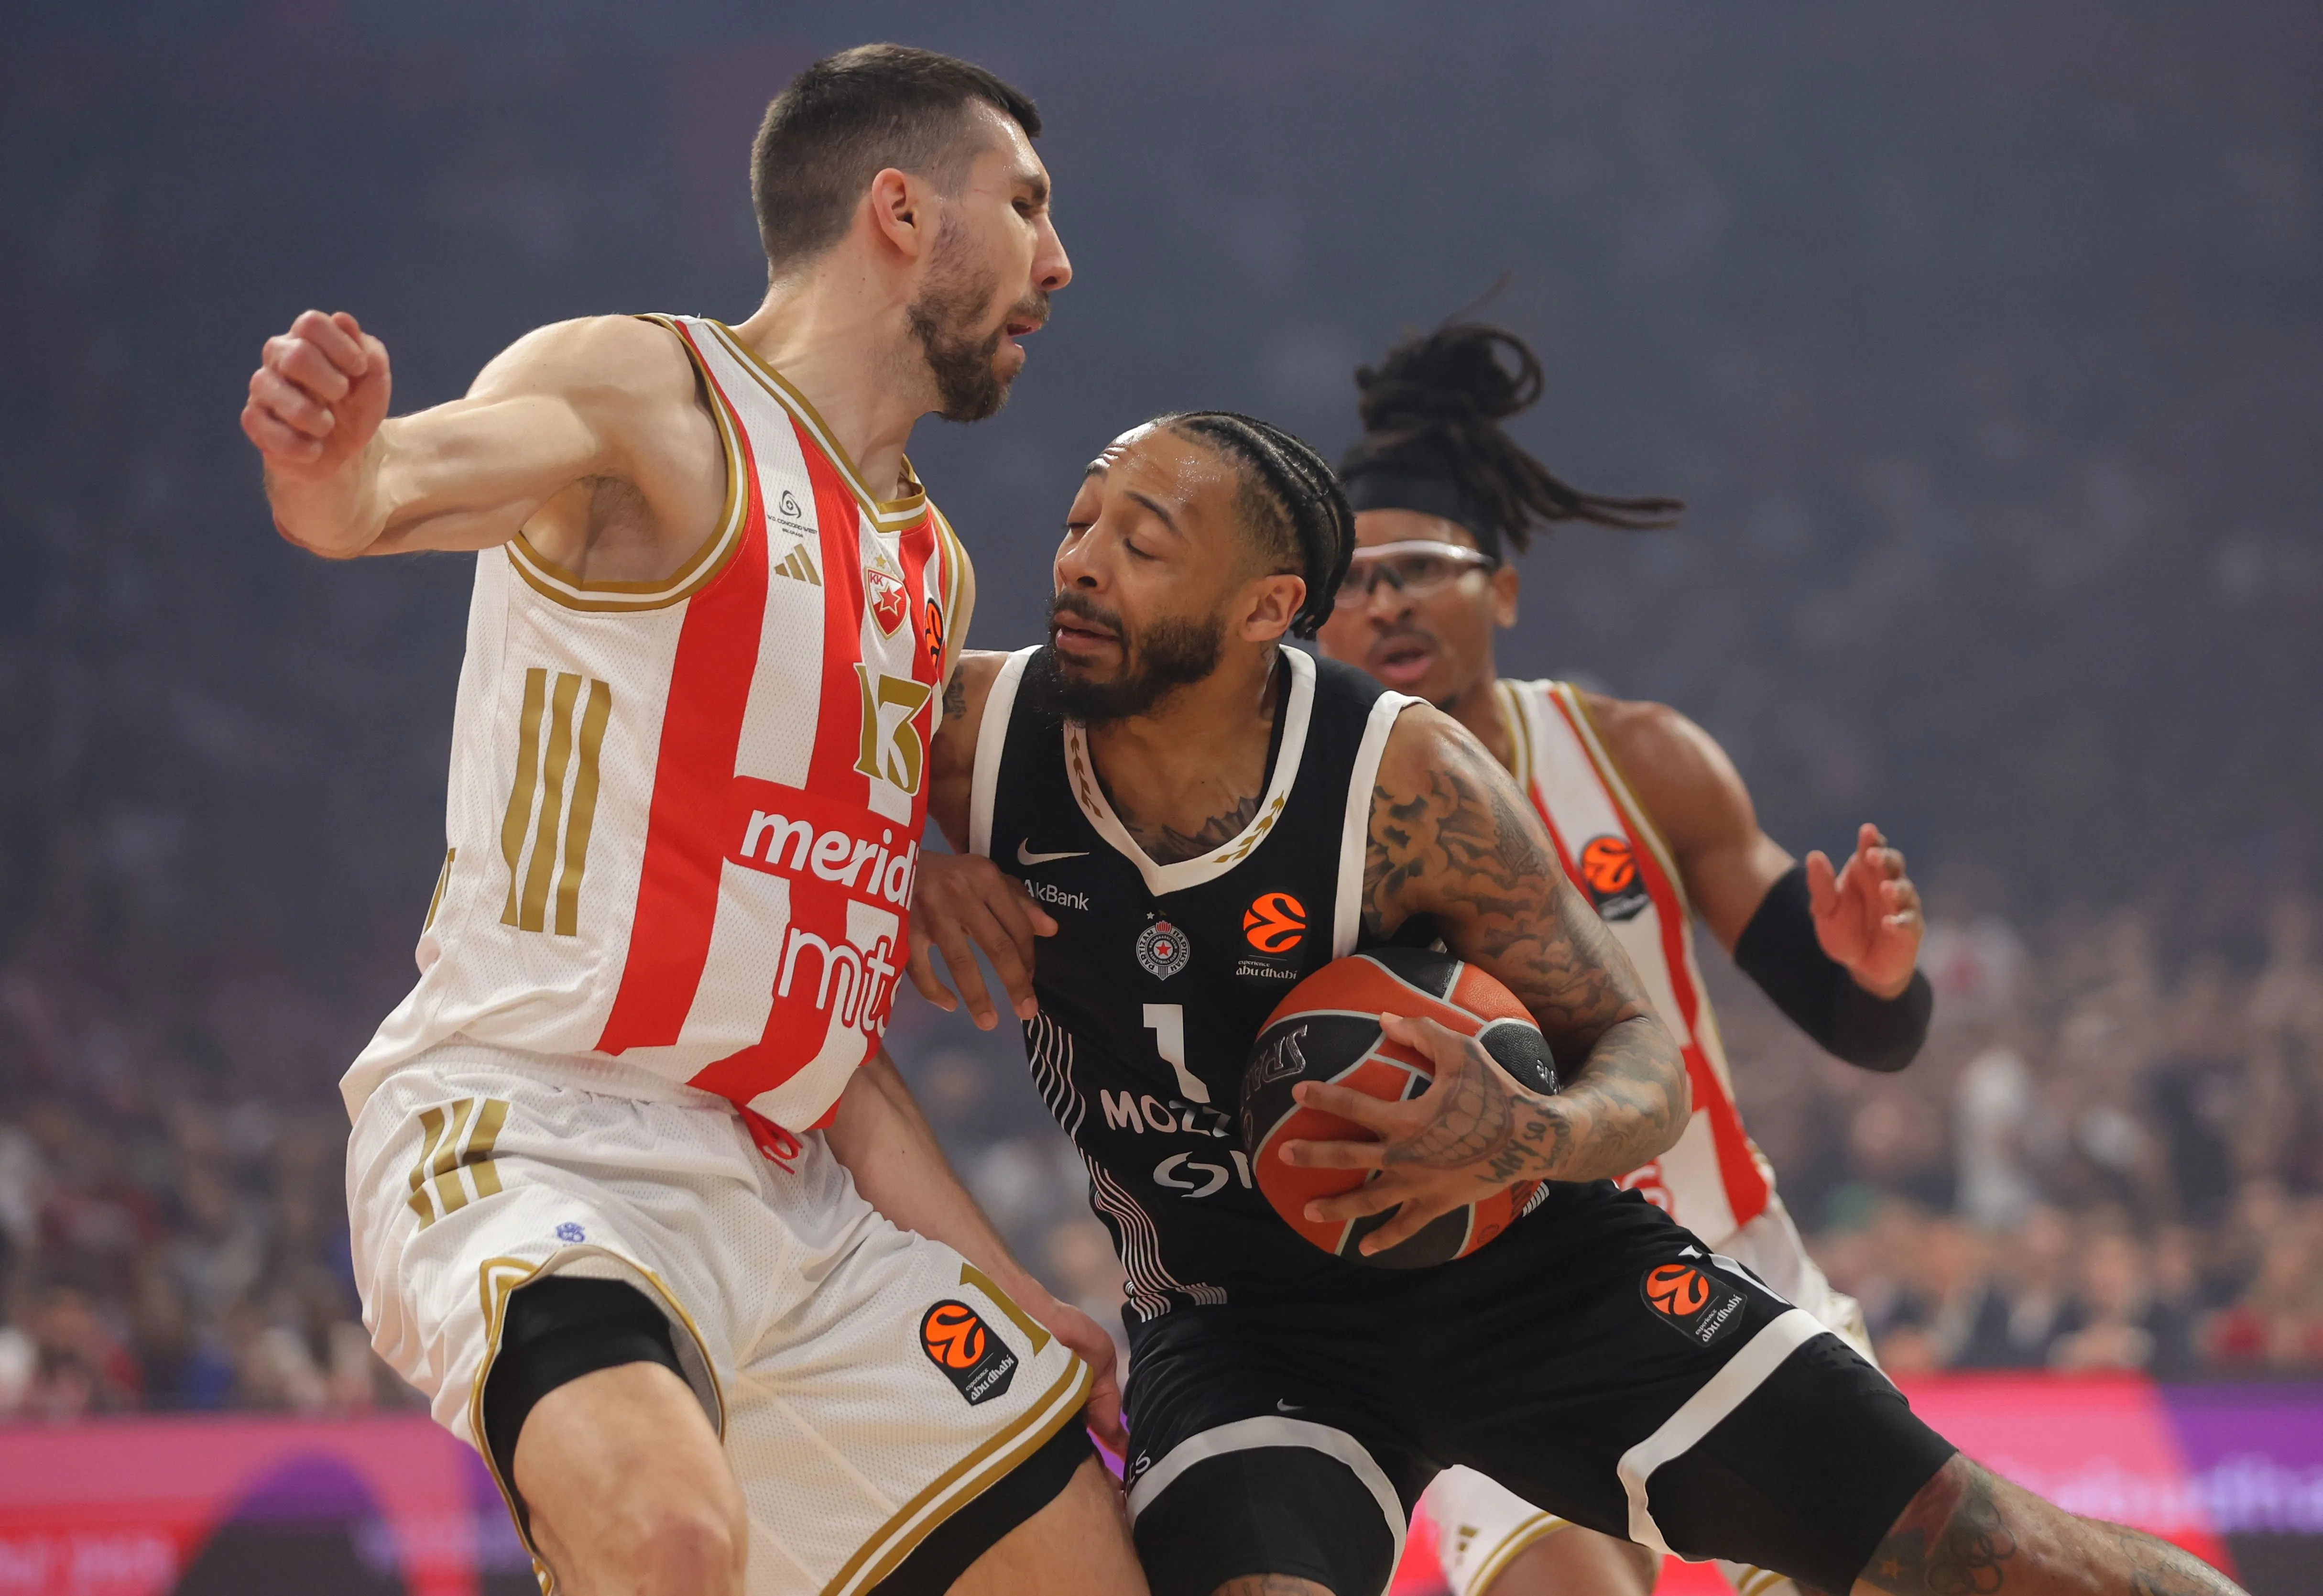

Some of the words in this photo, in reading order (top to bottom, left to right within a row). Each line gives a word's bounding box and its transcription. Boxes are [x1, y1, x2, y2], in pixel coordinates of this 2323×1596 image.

[870, 573, 883, 587] KK
[854, 663, 932, 797] 13
[1025, 879, 1090, 911] AkBank
[1139, 929, 1156, 971] PARTIZAN
[1236, 965, 1259, 976] abu
[1260, 967, 1298, 979] dhabi
[1143, 1003, 1211, 1104] 1
[1695, 1309, 1717, 1335] experience
[1702, 1320, 1721, 1342] abu
[1717, 1294, 1743, 1323] dhabi
[966, 1367, 989, 1391] experience
[971, 1380, 990, 1401] abu
[987, 1354, 1014, 1384] dhabi
